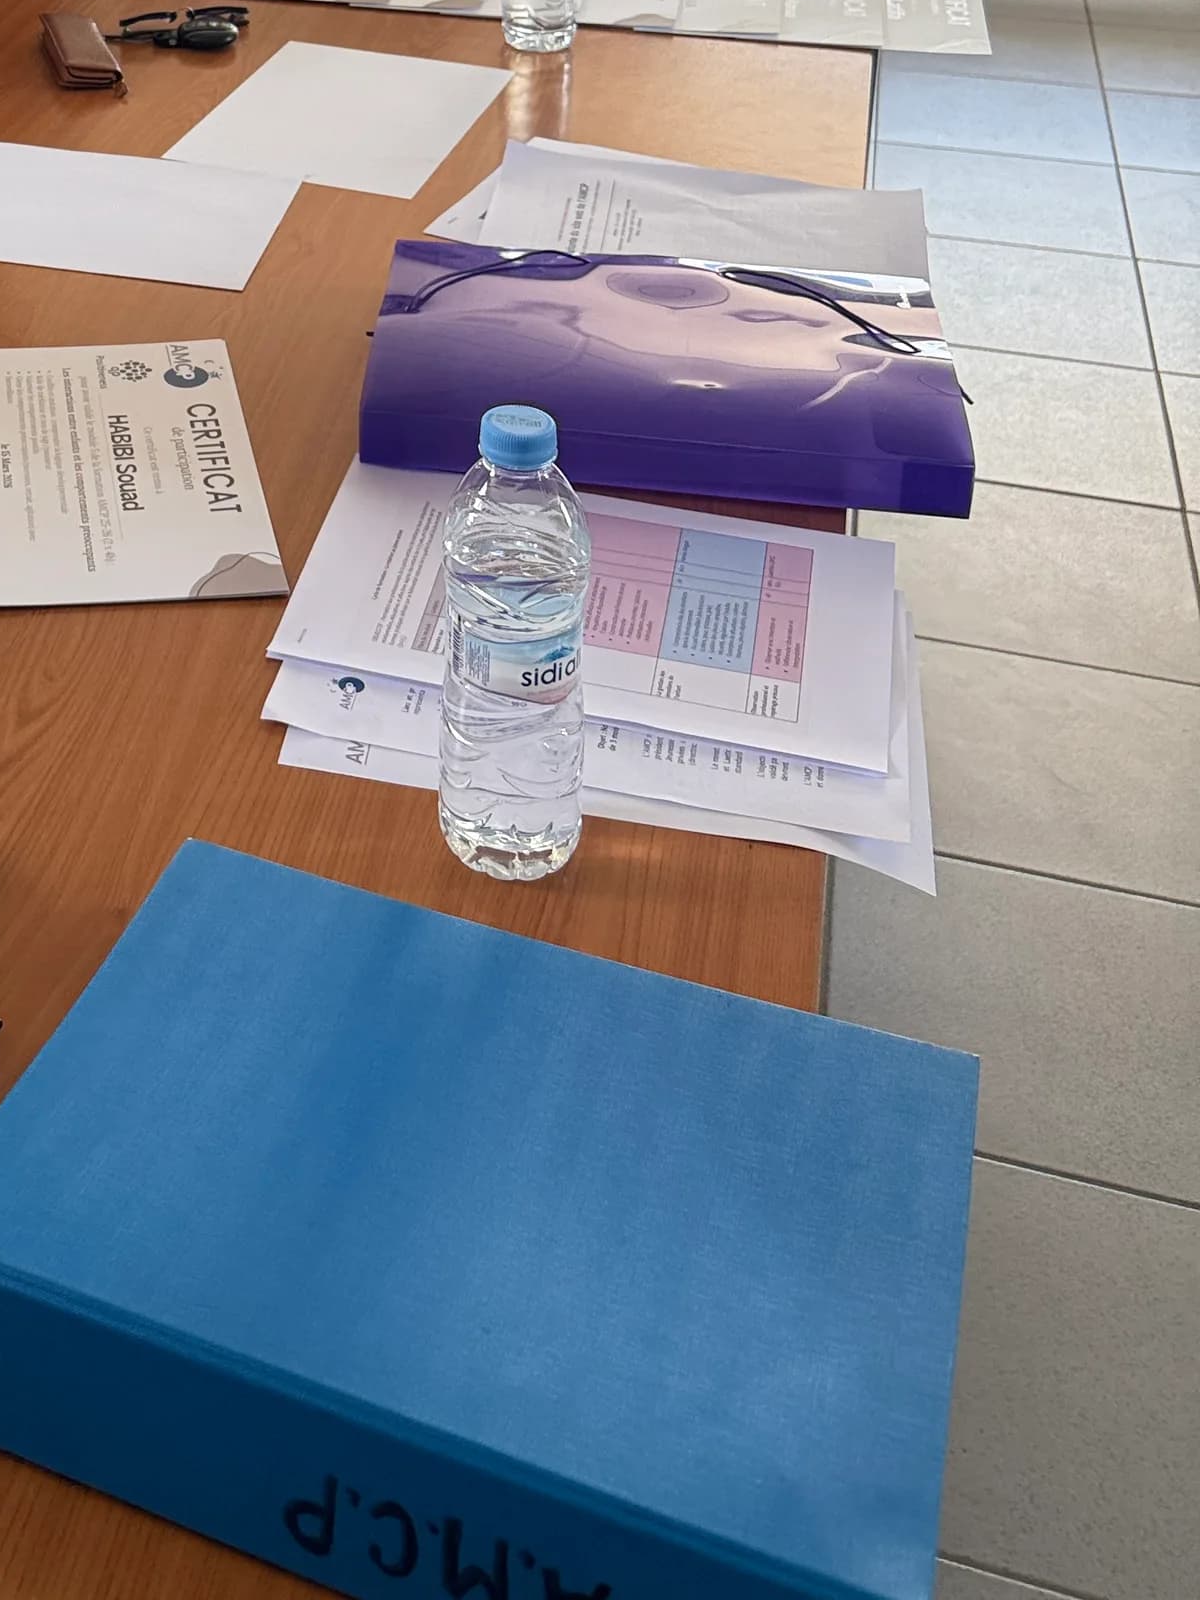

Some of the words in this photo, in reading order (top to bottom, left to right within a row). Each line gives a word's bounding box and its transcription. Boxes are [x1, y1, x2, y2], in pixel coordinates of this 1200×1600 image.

[170, 344, 196, 380] AMCP
[108, 414, 135, 461] HABIBI
[172, 427, 185, 437] de
[170, 439, 194, 490] participation
[187, 404, 242, 512] CERTIFICAT
[116, 464, 145, 511] Souad
[520, 662, 562, 687] sidi
